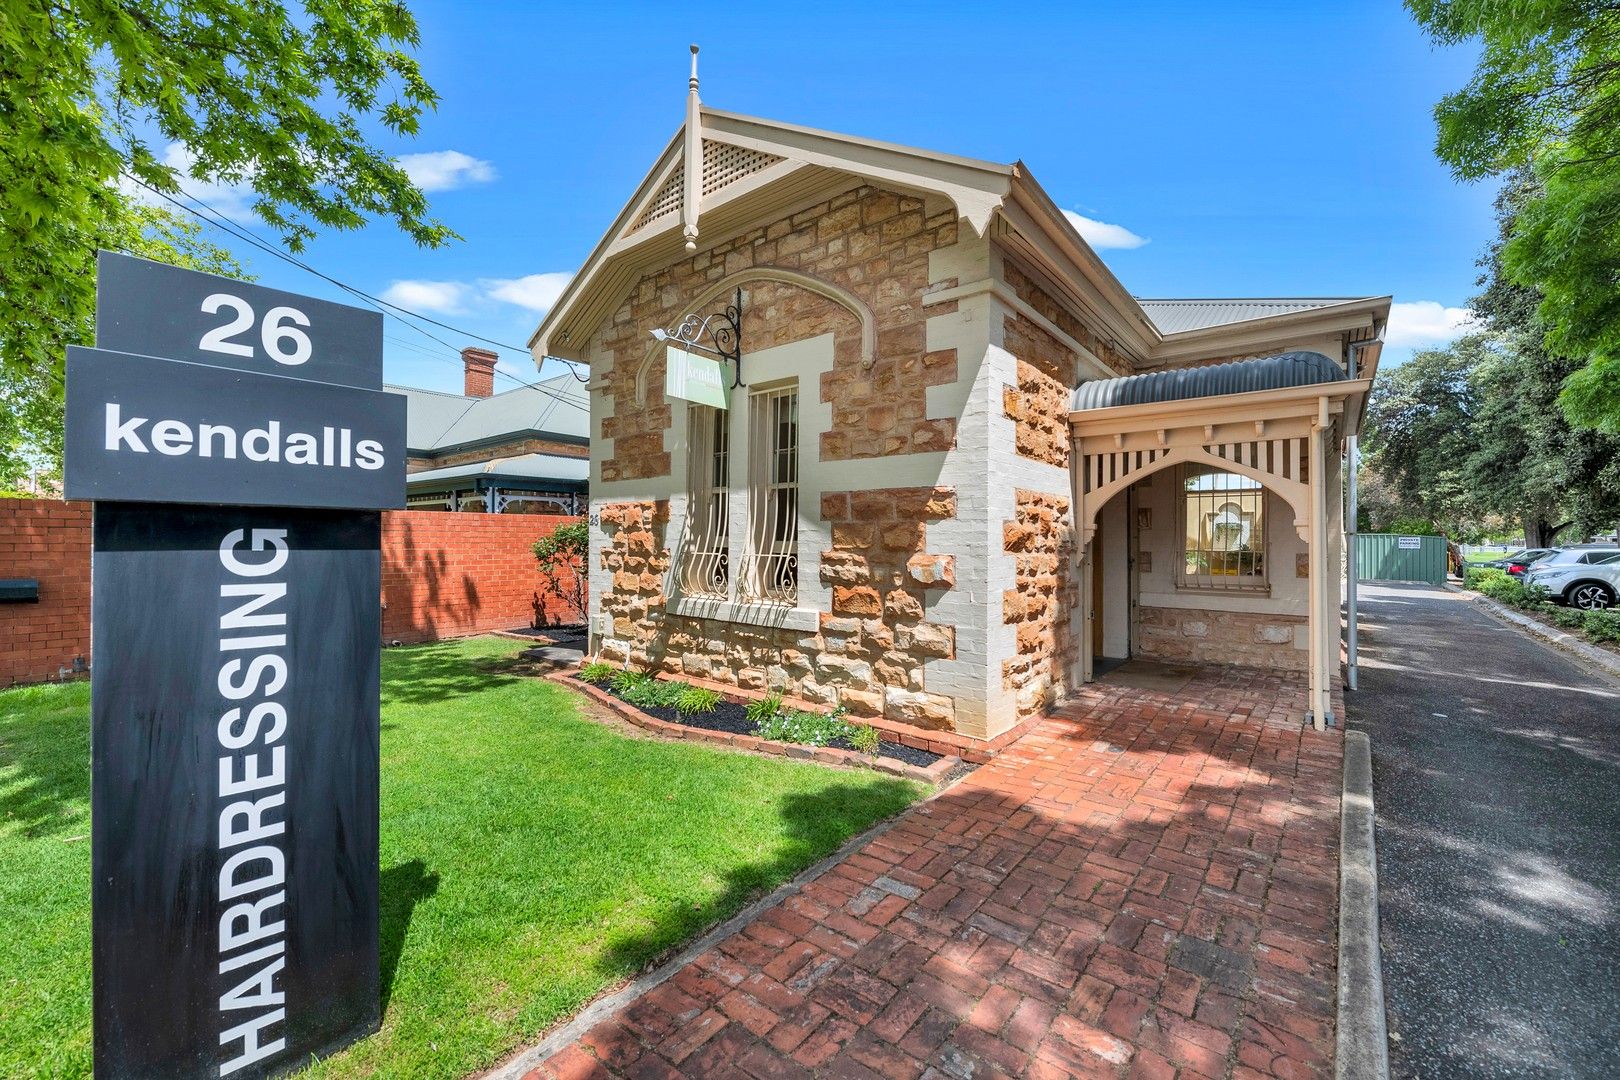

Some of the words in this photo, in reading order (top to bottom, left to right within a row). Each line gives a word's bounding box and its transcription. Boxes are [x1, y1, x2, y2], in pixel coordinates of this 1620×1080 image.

[198, 293, 313, 366] 26
[105, 403, 386, 471] kendalls
[217, 528, 290, 1078] HAIRDRESSING
